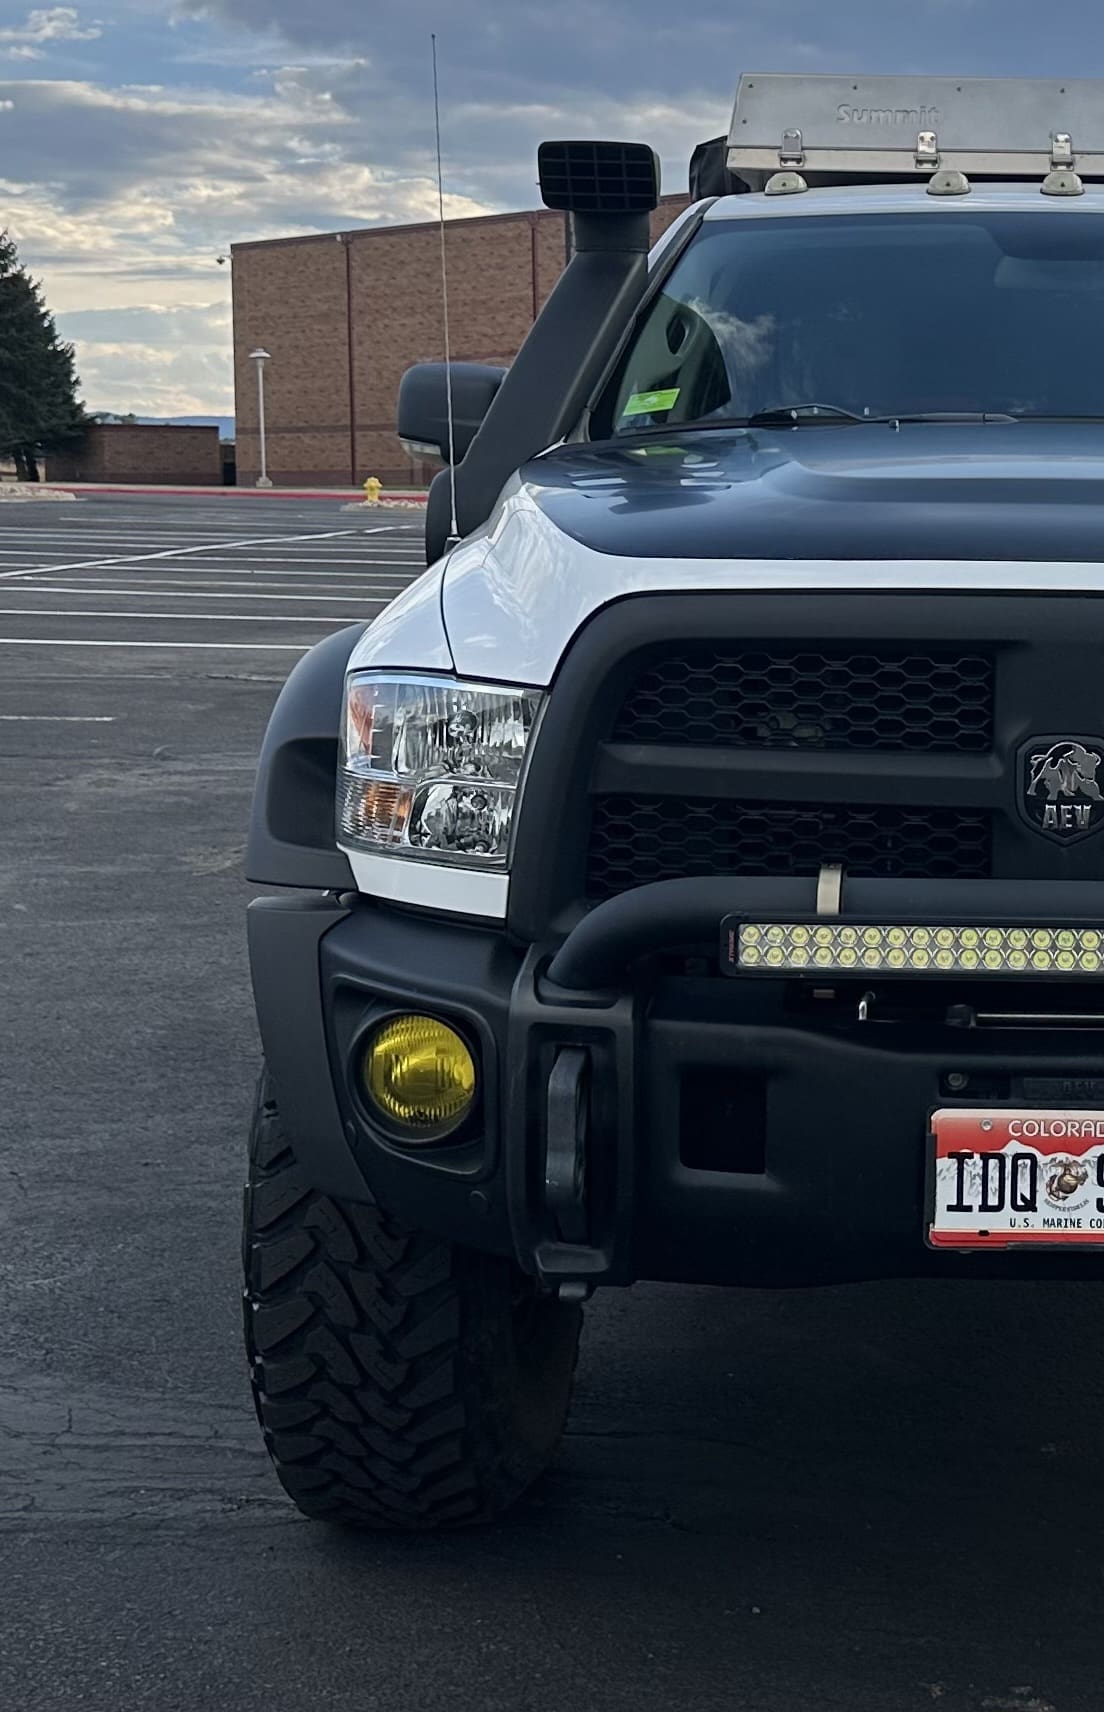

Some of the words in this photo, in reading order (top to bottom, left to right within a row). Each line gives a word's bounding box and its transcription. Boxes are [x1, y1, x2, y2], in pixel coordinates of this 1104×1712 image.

[836, 103, 940, 125] Summit
[1042, 804, 1092, 829] AEV
[946, 1151, 1038, 1213] IDQ
[1009, 1217, 1035, 1229] U.S.
[1042, 1217, 1083, 1229] MARINE
